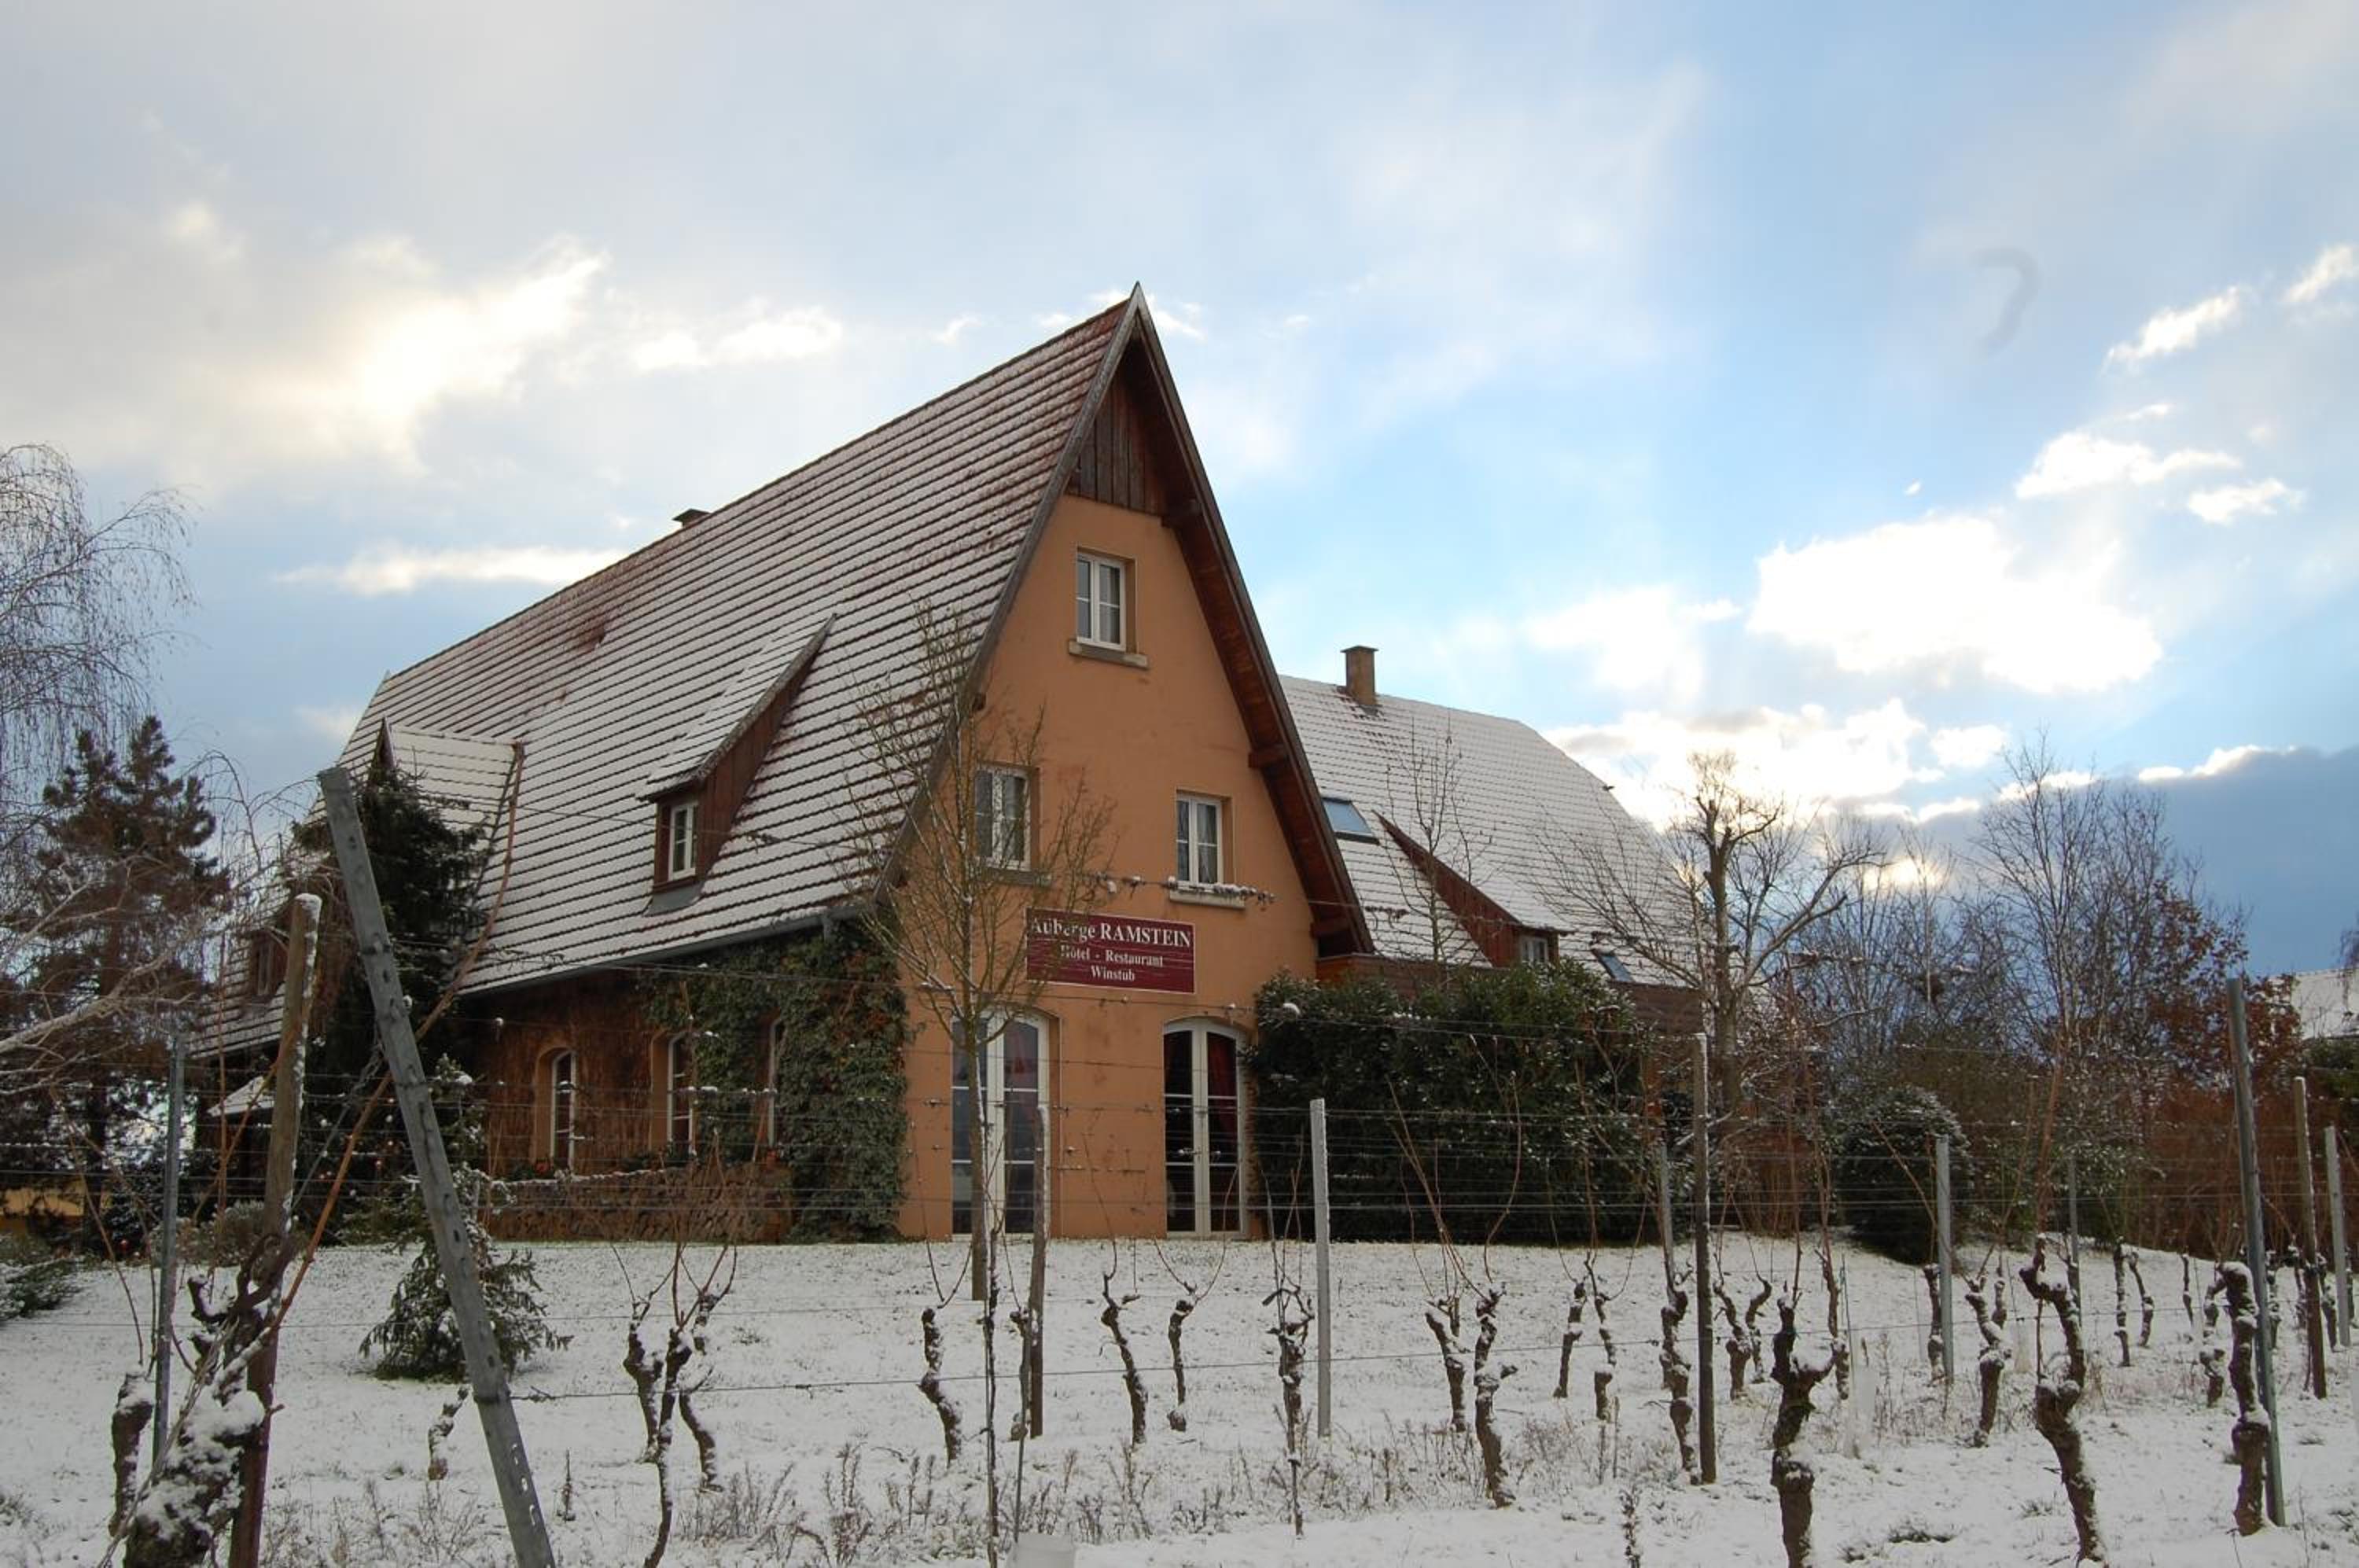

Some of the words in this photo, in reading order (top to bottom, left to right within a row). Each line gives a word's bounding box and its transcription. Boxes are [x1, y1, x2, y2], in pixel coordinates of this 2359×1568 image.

[1031, 918, 1095, 942] Auberge
[1101, 922, 1191, 948] RAMSTEIN
[1105, 949, 1163, 968] Restaurant
[1091, 965, 1135, 981] Winstub
